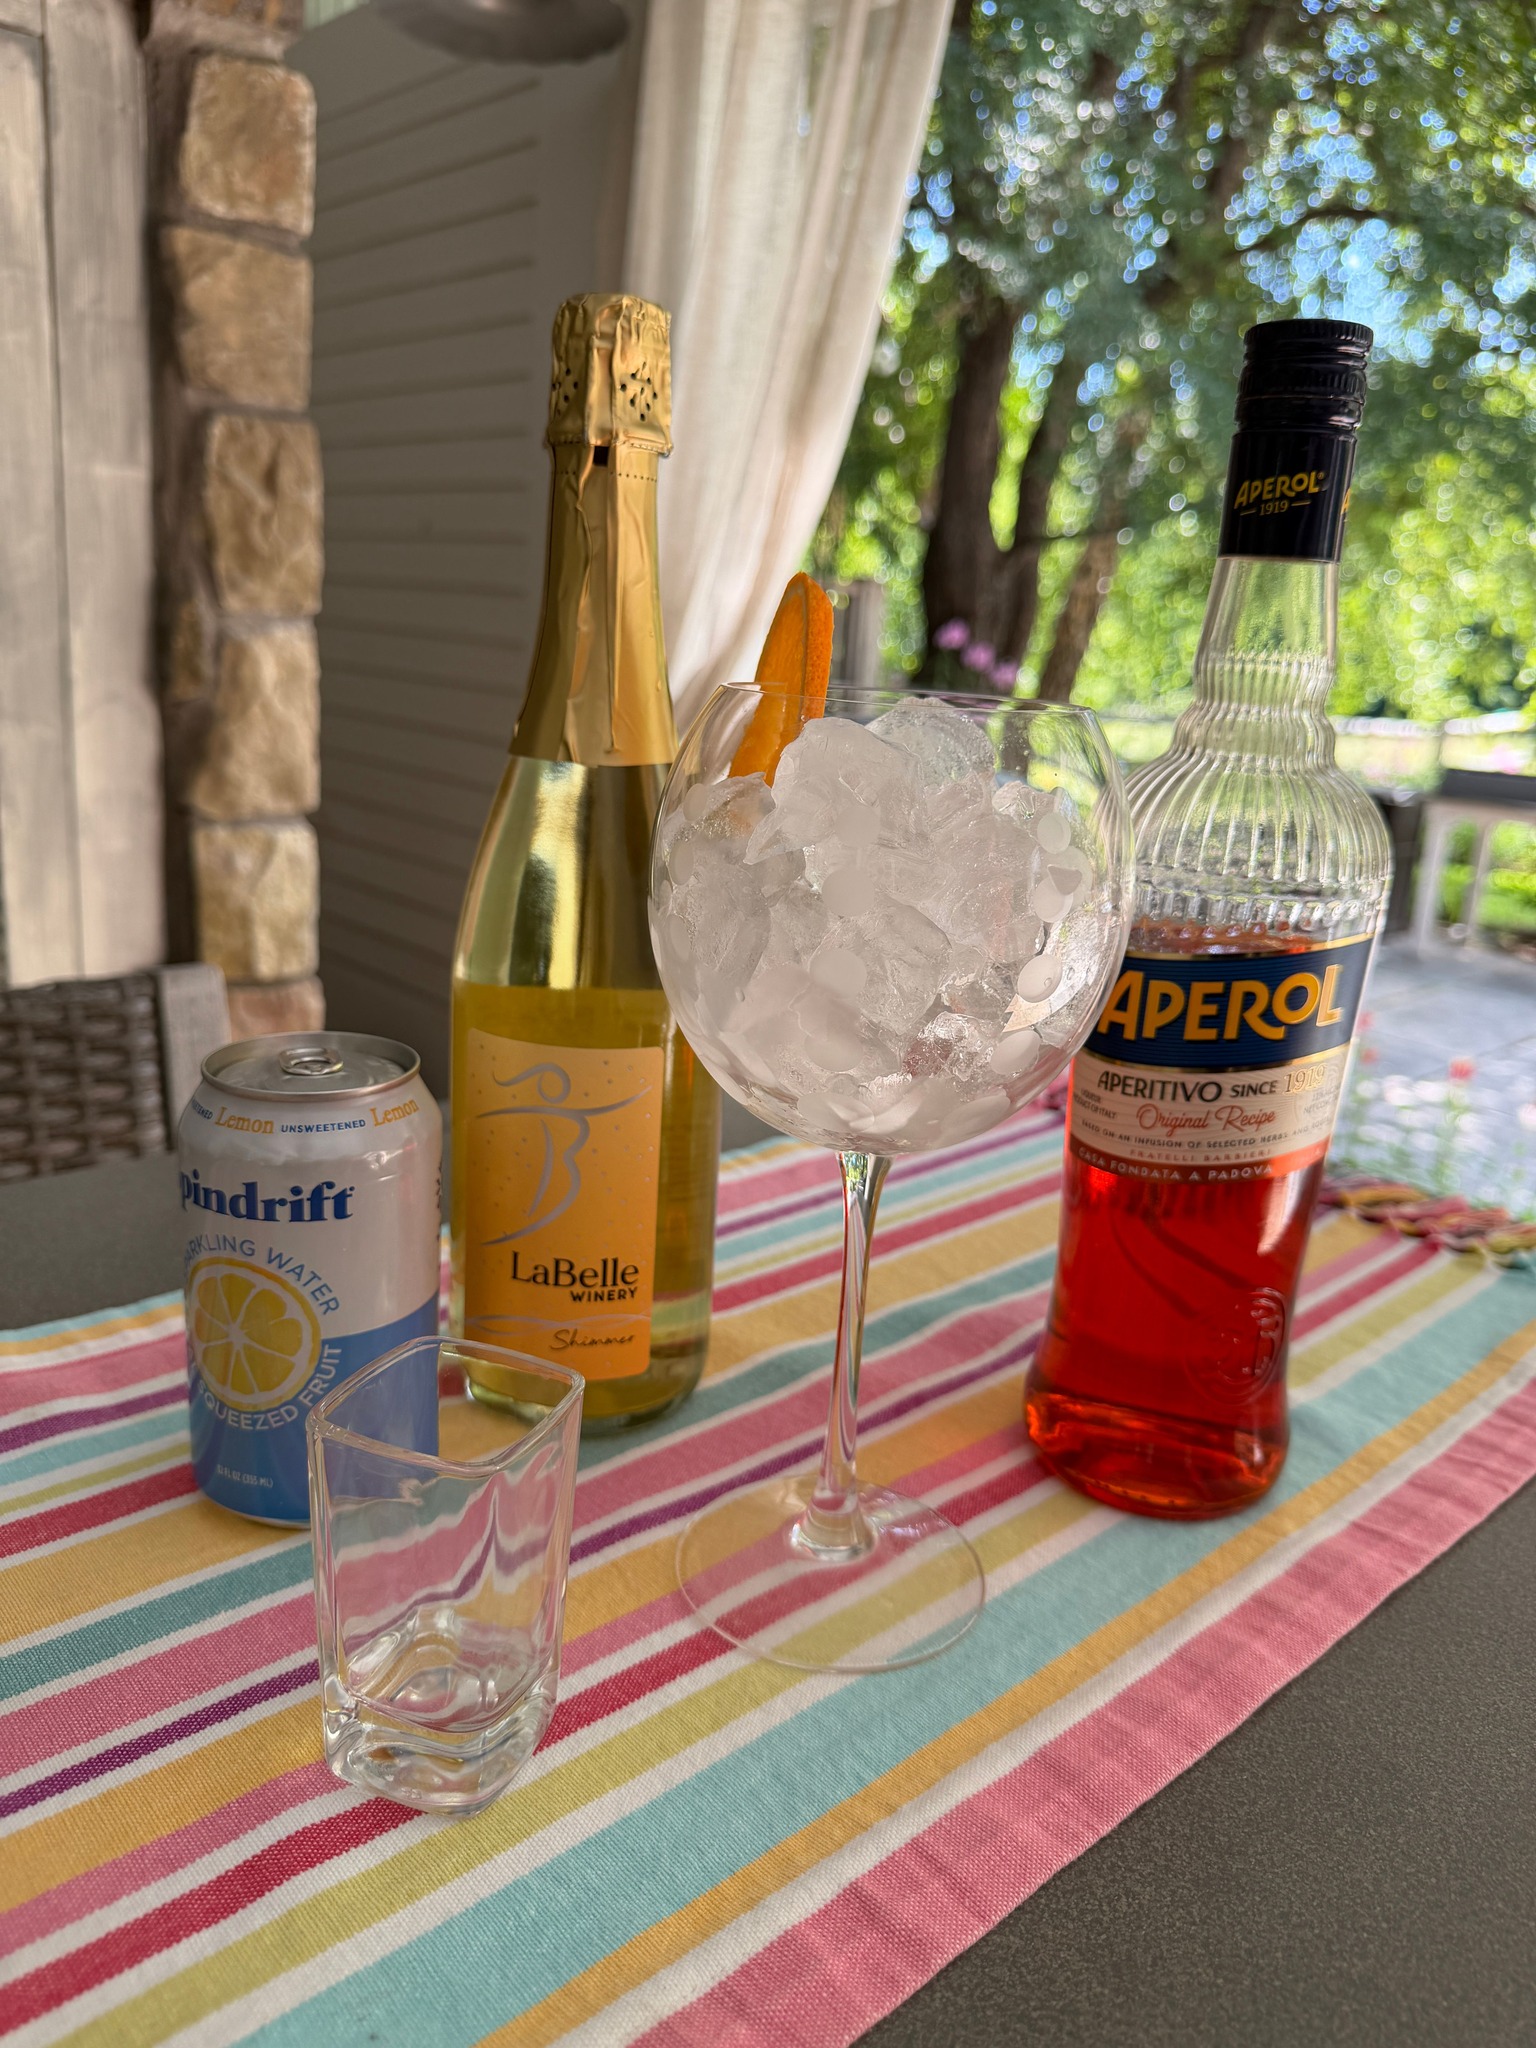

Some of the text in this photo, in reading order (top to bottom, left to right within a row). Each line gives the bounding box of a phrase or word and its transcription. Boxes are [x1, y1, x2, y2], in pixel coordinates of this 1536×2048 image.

[1234, 471, 1320, 510] APEROL
[1259, 501, 1289, 516] 1919
[1097, 964, 1344, 1041] APEROL
[1098, 1070, 1223, 1103] APERITIVO
[1230, 1079, 1278, 1098] SINCE
[1282, 1063, 1326, 1097] 1919
[214, 1106, 274, 1134] Lemon
[280, 1119, 366, 1134] UNSWEETENED
[369, 1099, 420, 1127] Lemon
[1136, 1103, 1276, 1137] Original Recipe
[1130, 1148, 1272, 1162] FRATELLI BARBIERI
[1134, 1137, 1182, 1148] INFUSION
[1206, 1138, 1256, 1149] SELECTED
[1078, 1147, 1274, 1181] CASA FONDATA A PADOVA
[180, 1168, 356, 1223] pindrift
[267, 1247, 340, 1315] WATER
[512, 1251, 639, 1289] LaBelle
[570, 1286, 638, 1302] WINERY
[550, 1328, 635, 1351] Shimmer
[198, 1344, 342, 1431] SQUEEZED FRUIT
